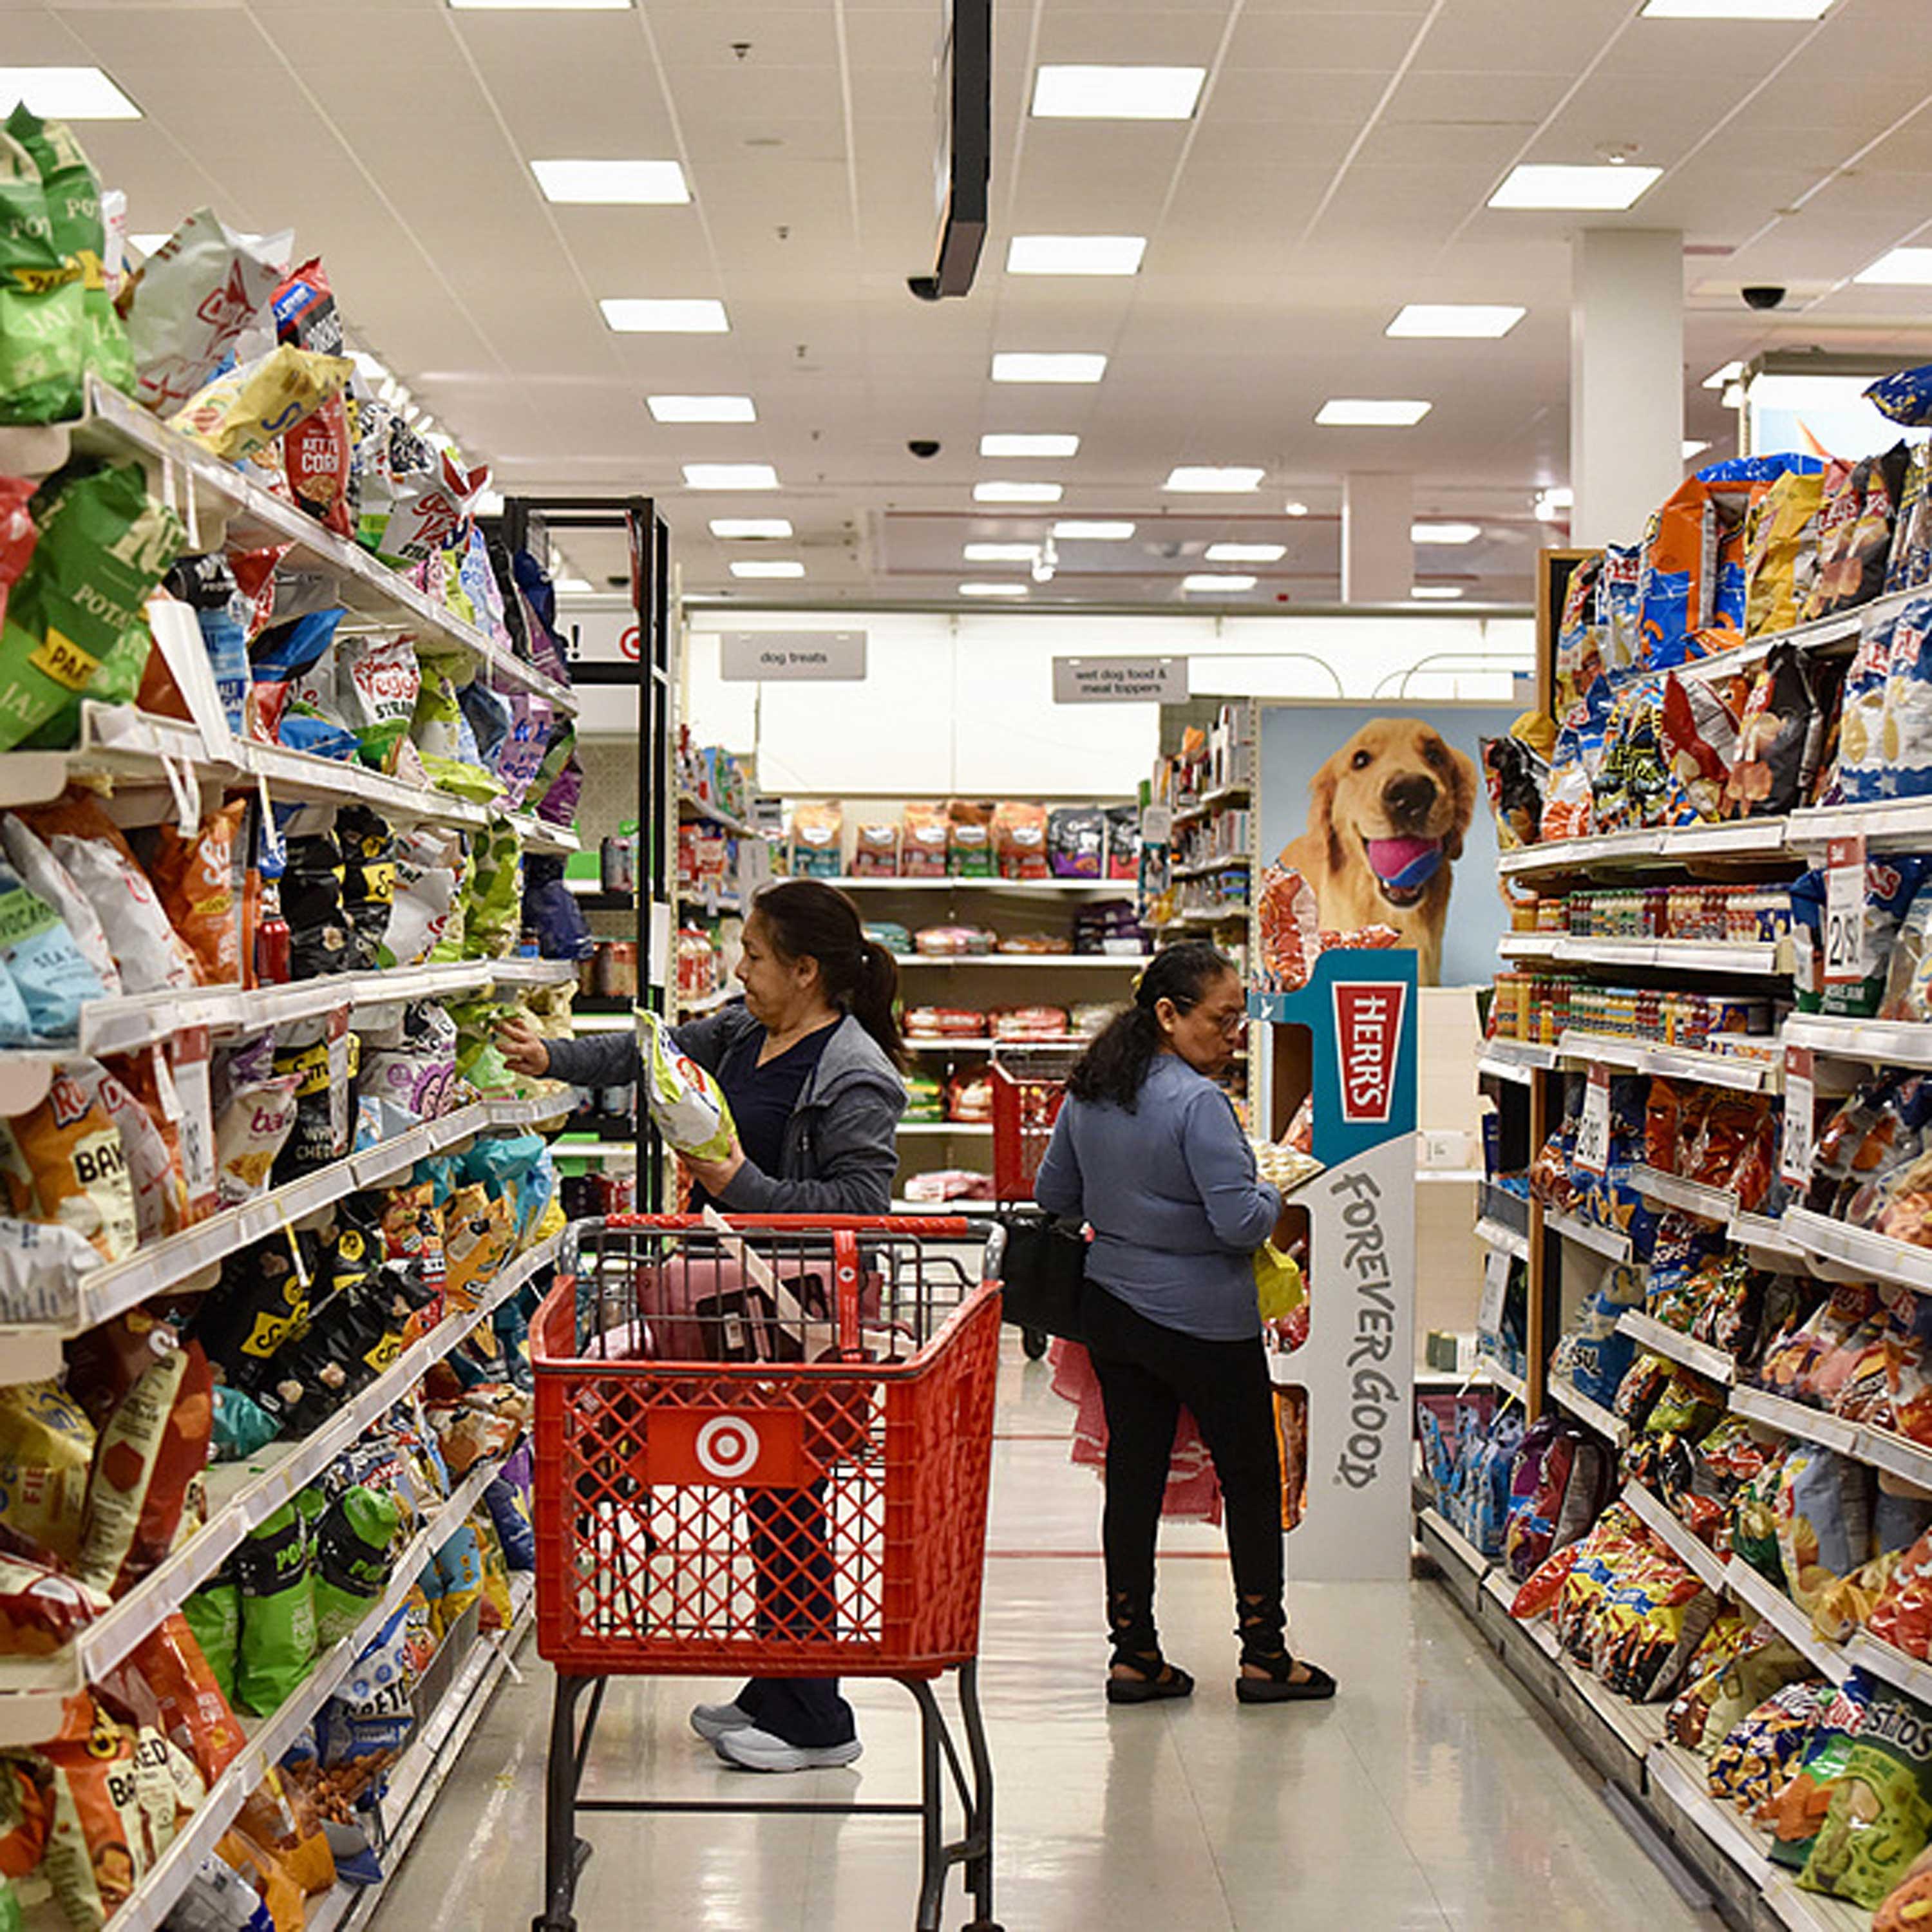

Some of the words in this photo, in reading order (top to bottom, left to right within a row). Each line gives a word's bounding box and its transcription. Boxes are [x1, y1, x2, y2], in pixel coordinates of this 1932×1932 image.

[761, 651, 786, 665] dog
[789, 652, 828, 664] treats
[1076, 670, 1098, 680] wet
[1101, 668, 1124, 681] dog
[1128, 668, 1155, 680] food
[1081, 683, 1112, 694] meal
[1114, 683, 1161, 694] toppers
[1349, 996, 1388, 1107] HERR'S
[1330, 1172, 1396, 1367] FOREVER
[1336, 1368, 1400, 1489] GOOD
